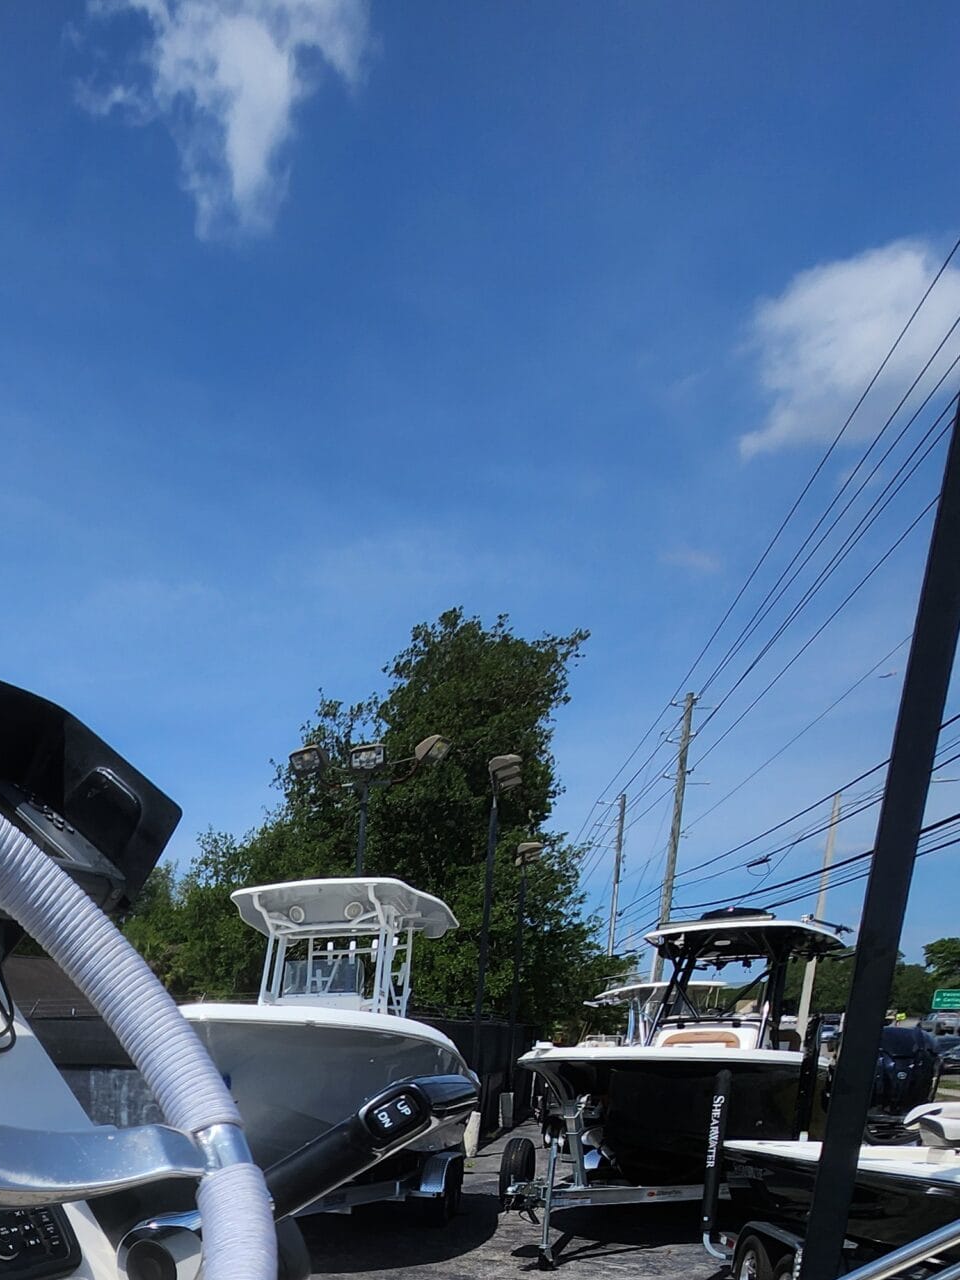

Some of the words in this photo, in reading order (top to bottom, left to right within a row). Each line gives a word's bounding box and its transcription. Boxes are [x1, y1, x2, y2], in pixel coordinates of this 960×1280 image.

[396, 1100, 412, 1115] UP
[377, 1111, 393, 1128] DN
[706, 1095, 725, 1168] SHEARWATER
